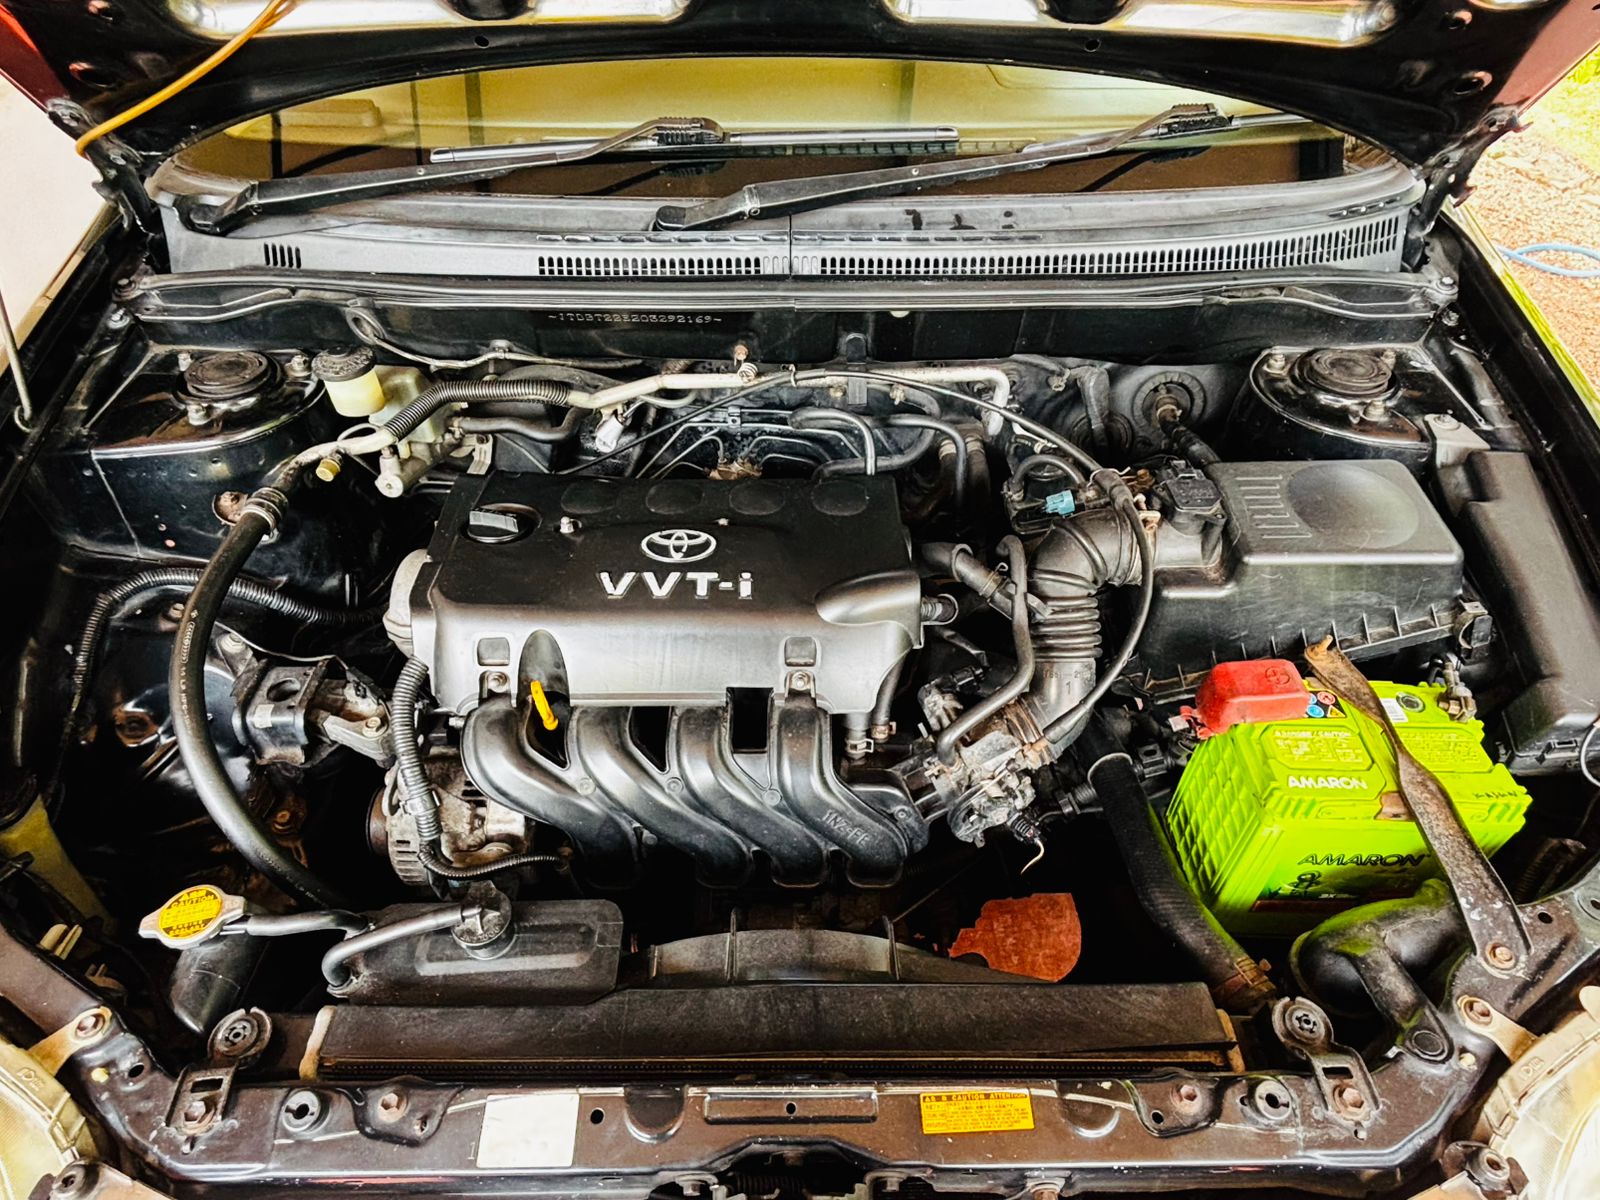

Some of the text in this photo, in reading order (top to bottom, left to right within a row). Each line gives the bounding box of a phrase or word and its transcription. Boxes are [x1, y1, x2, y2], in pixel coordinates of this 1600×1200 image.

[597, 571, 753, 600] VVT-i
[1289, 775, 1368, 790] AMARON
[1298, 853, 1425, 867] AMARON
[952, 1093, 985, 1101] CAUTION
